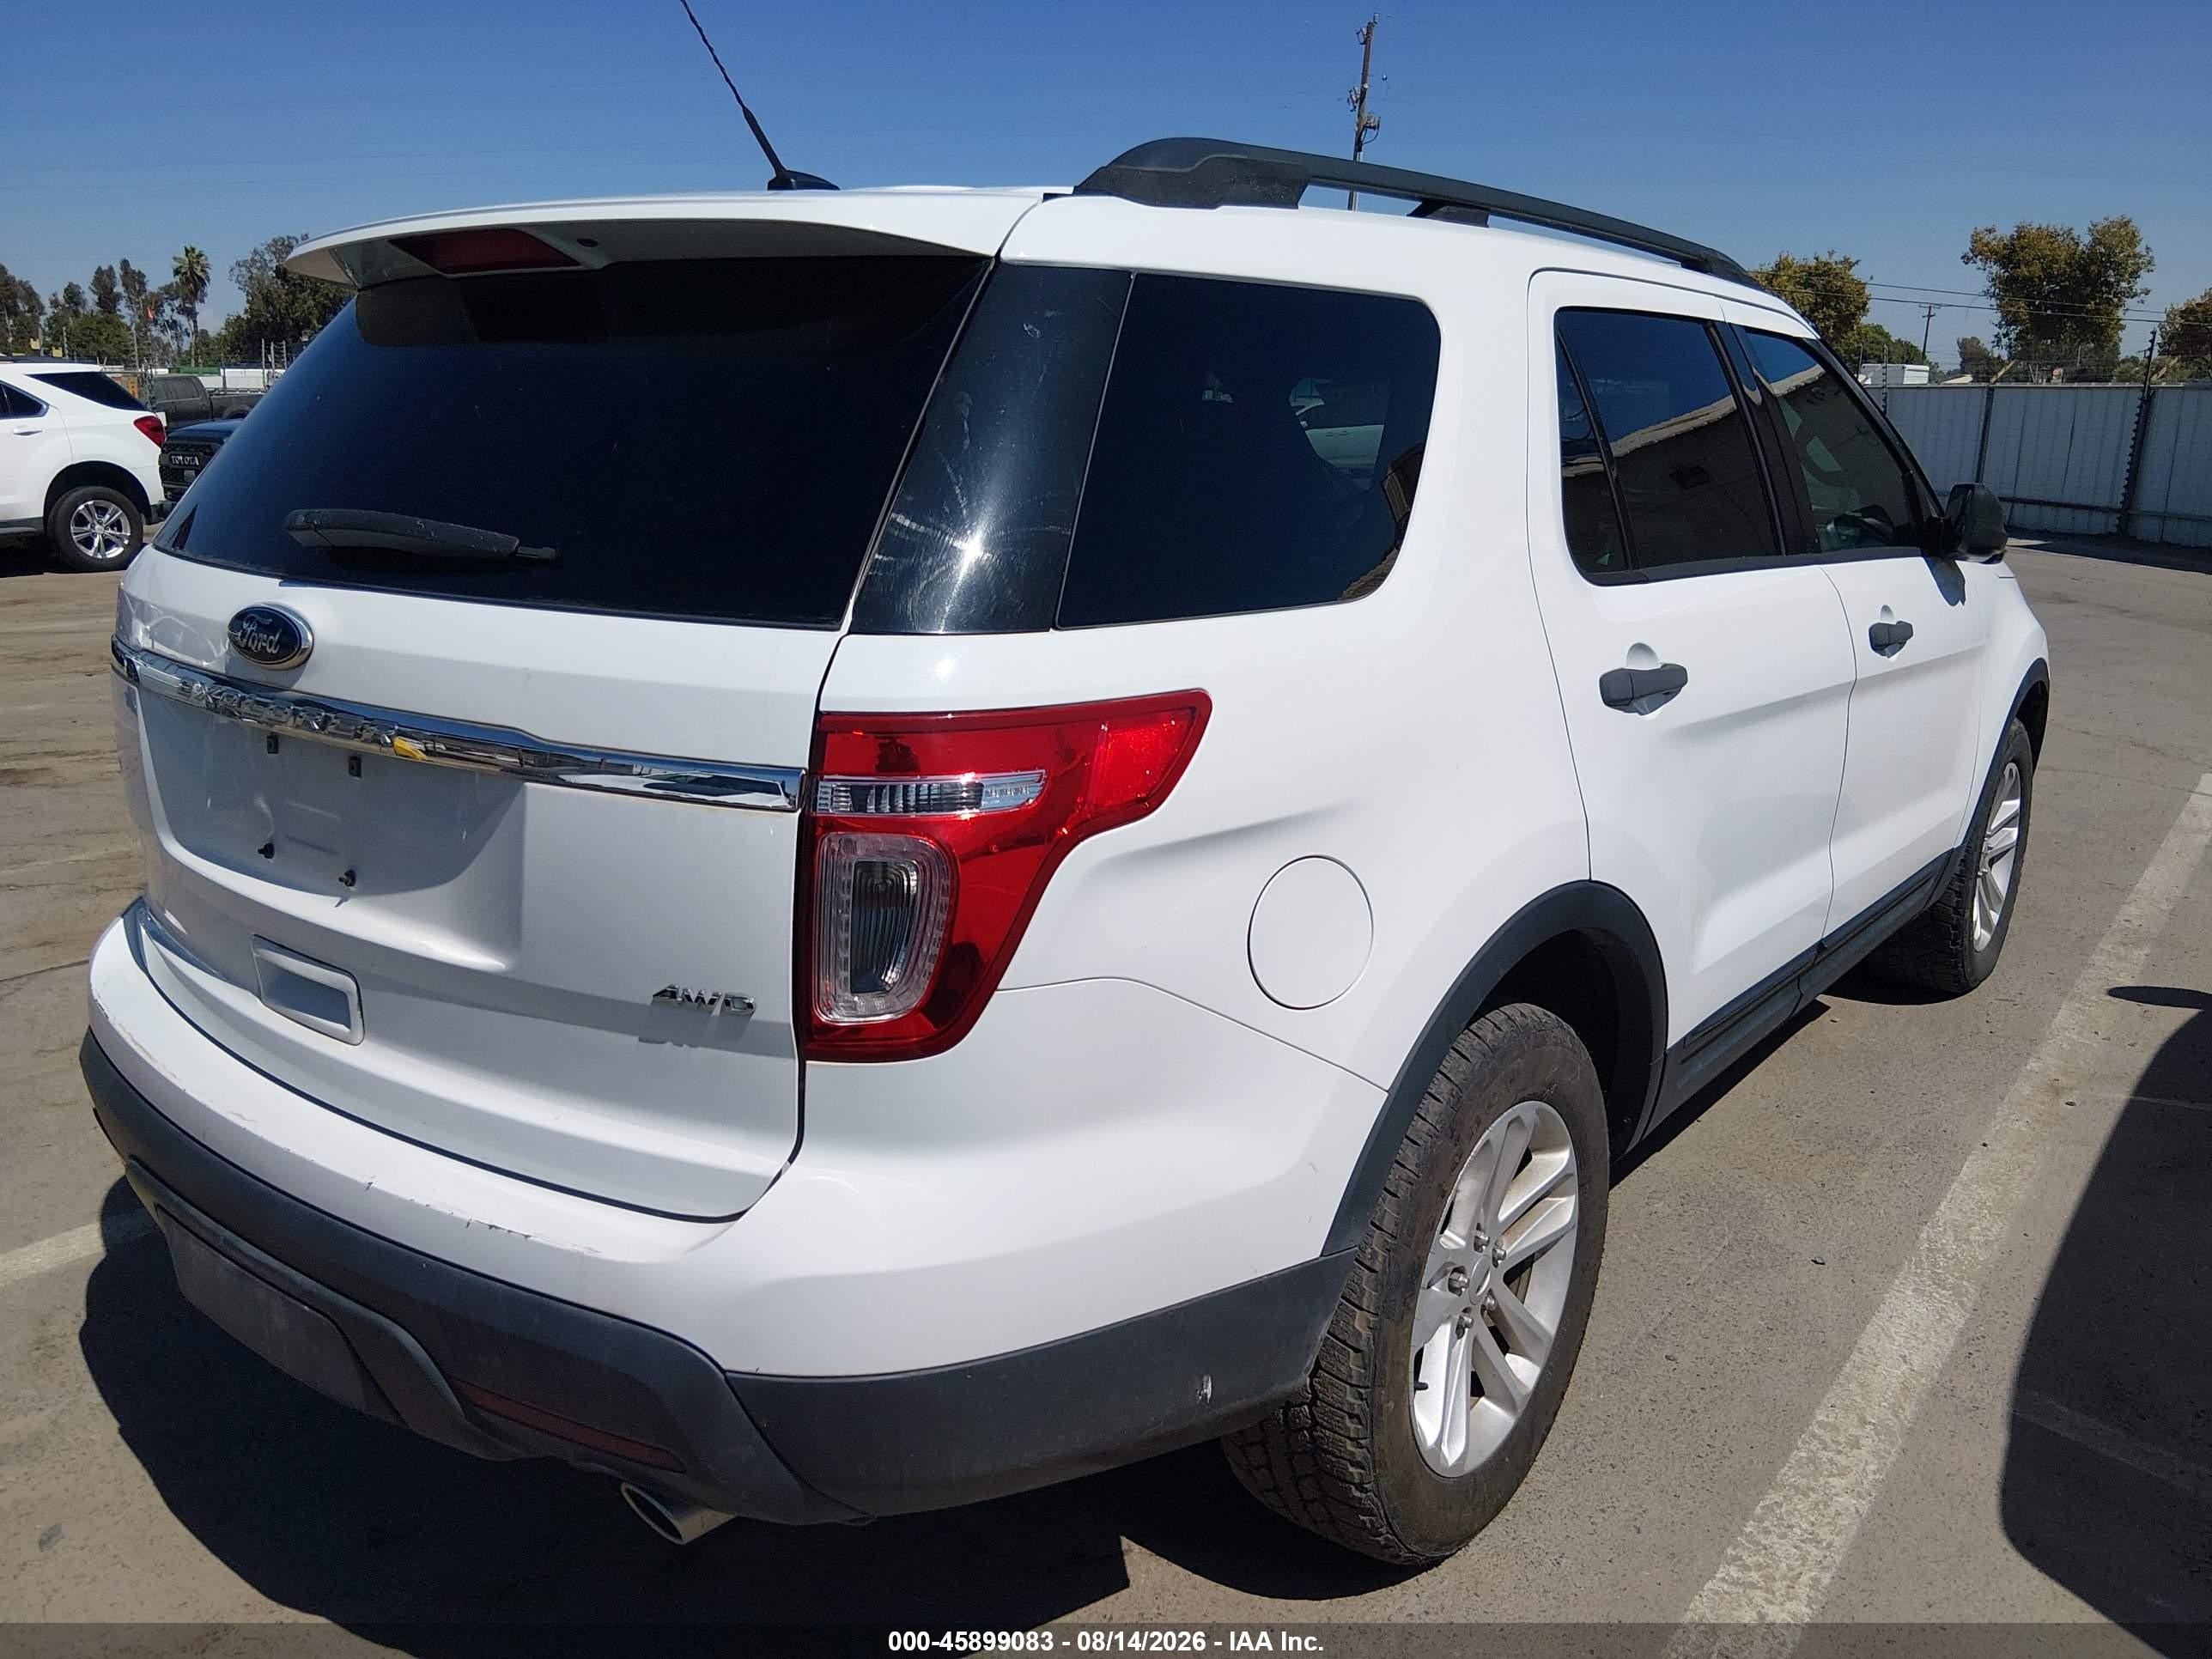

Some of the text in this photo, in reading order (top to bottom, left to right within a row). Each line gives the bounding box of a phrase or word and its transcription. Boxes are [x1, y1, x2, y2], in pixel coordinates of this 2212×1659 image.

[171, 454, 199, 465] TOYOTA
[235, 613, 283, 653] Ford
[651, 984, 757, 1015] AWD
